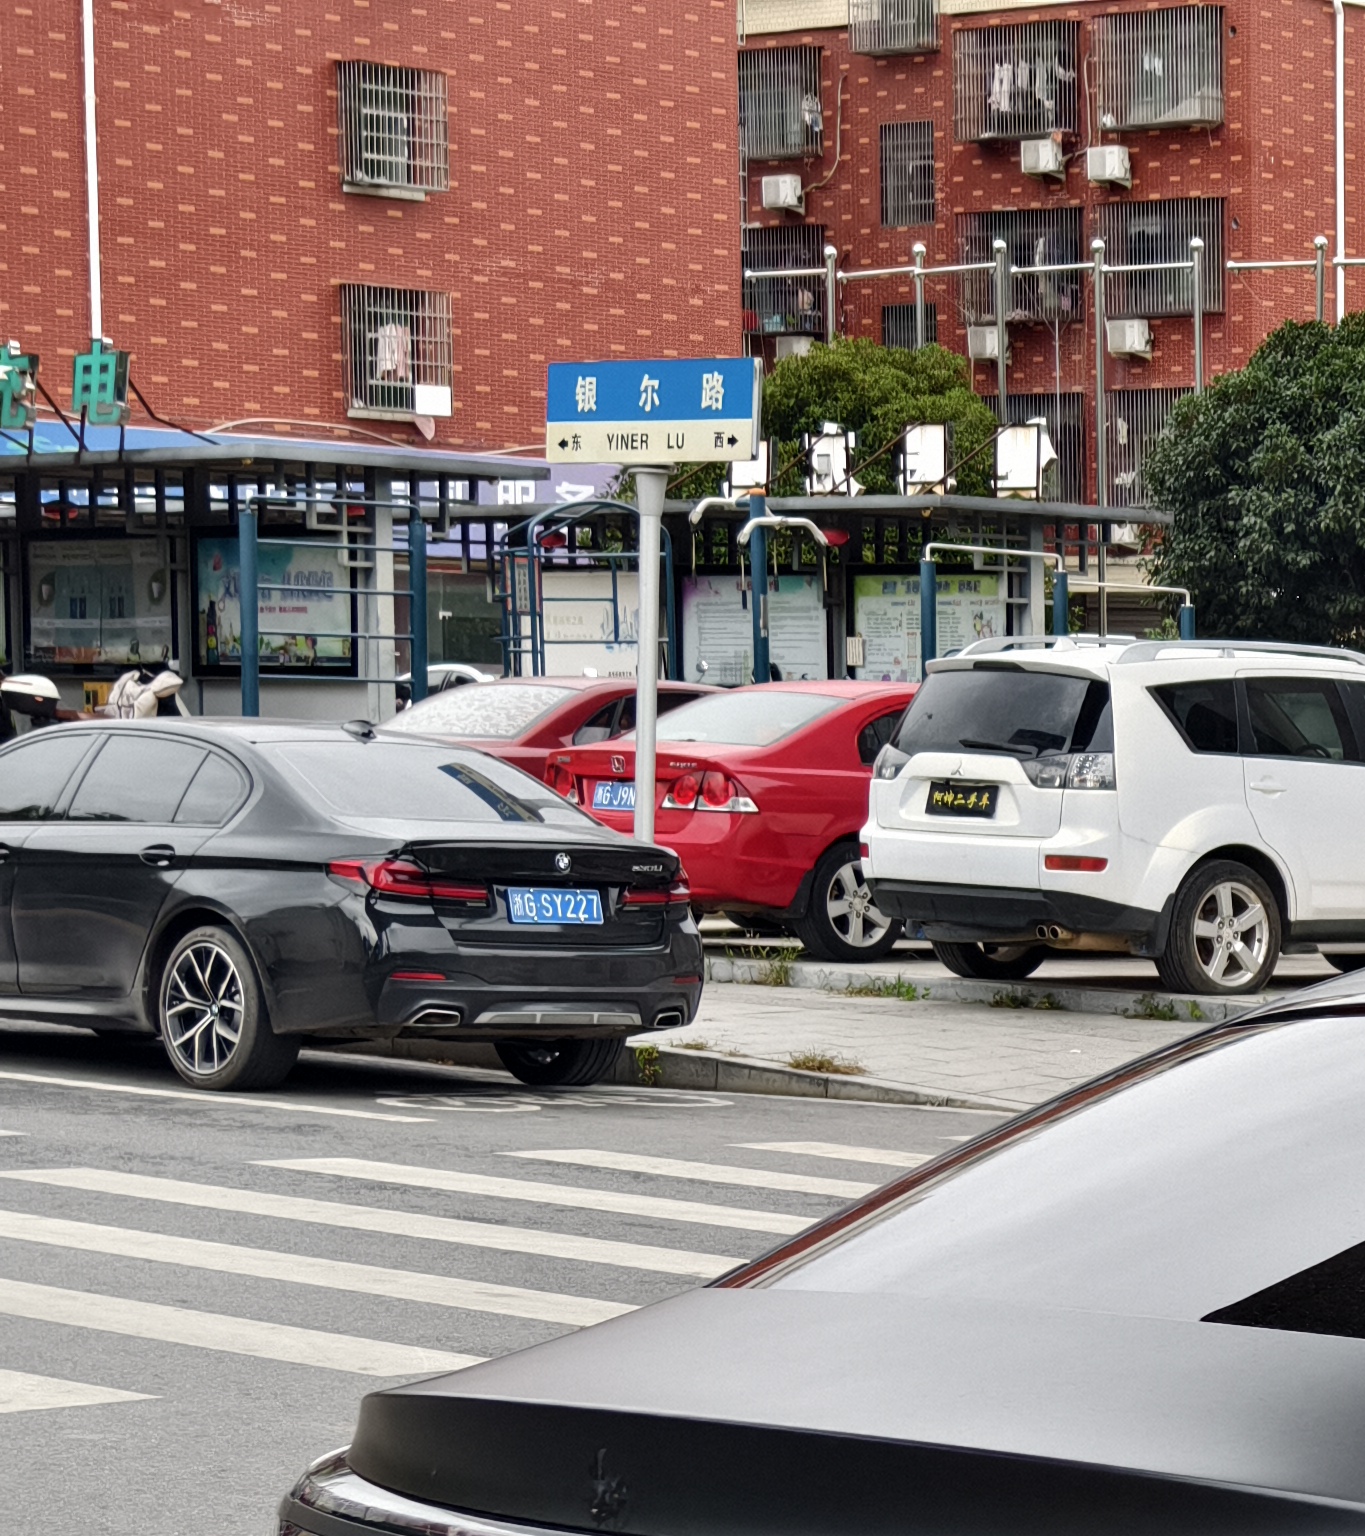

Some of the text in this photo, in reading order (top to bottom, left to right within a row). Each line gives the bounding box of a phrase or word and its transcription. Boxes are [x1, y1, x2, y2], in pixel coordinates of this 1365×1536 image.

[575, 371, 724, 413] 银尔路
[571, 432, 725, 451] 东 YINER LU 西
